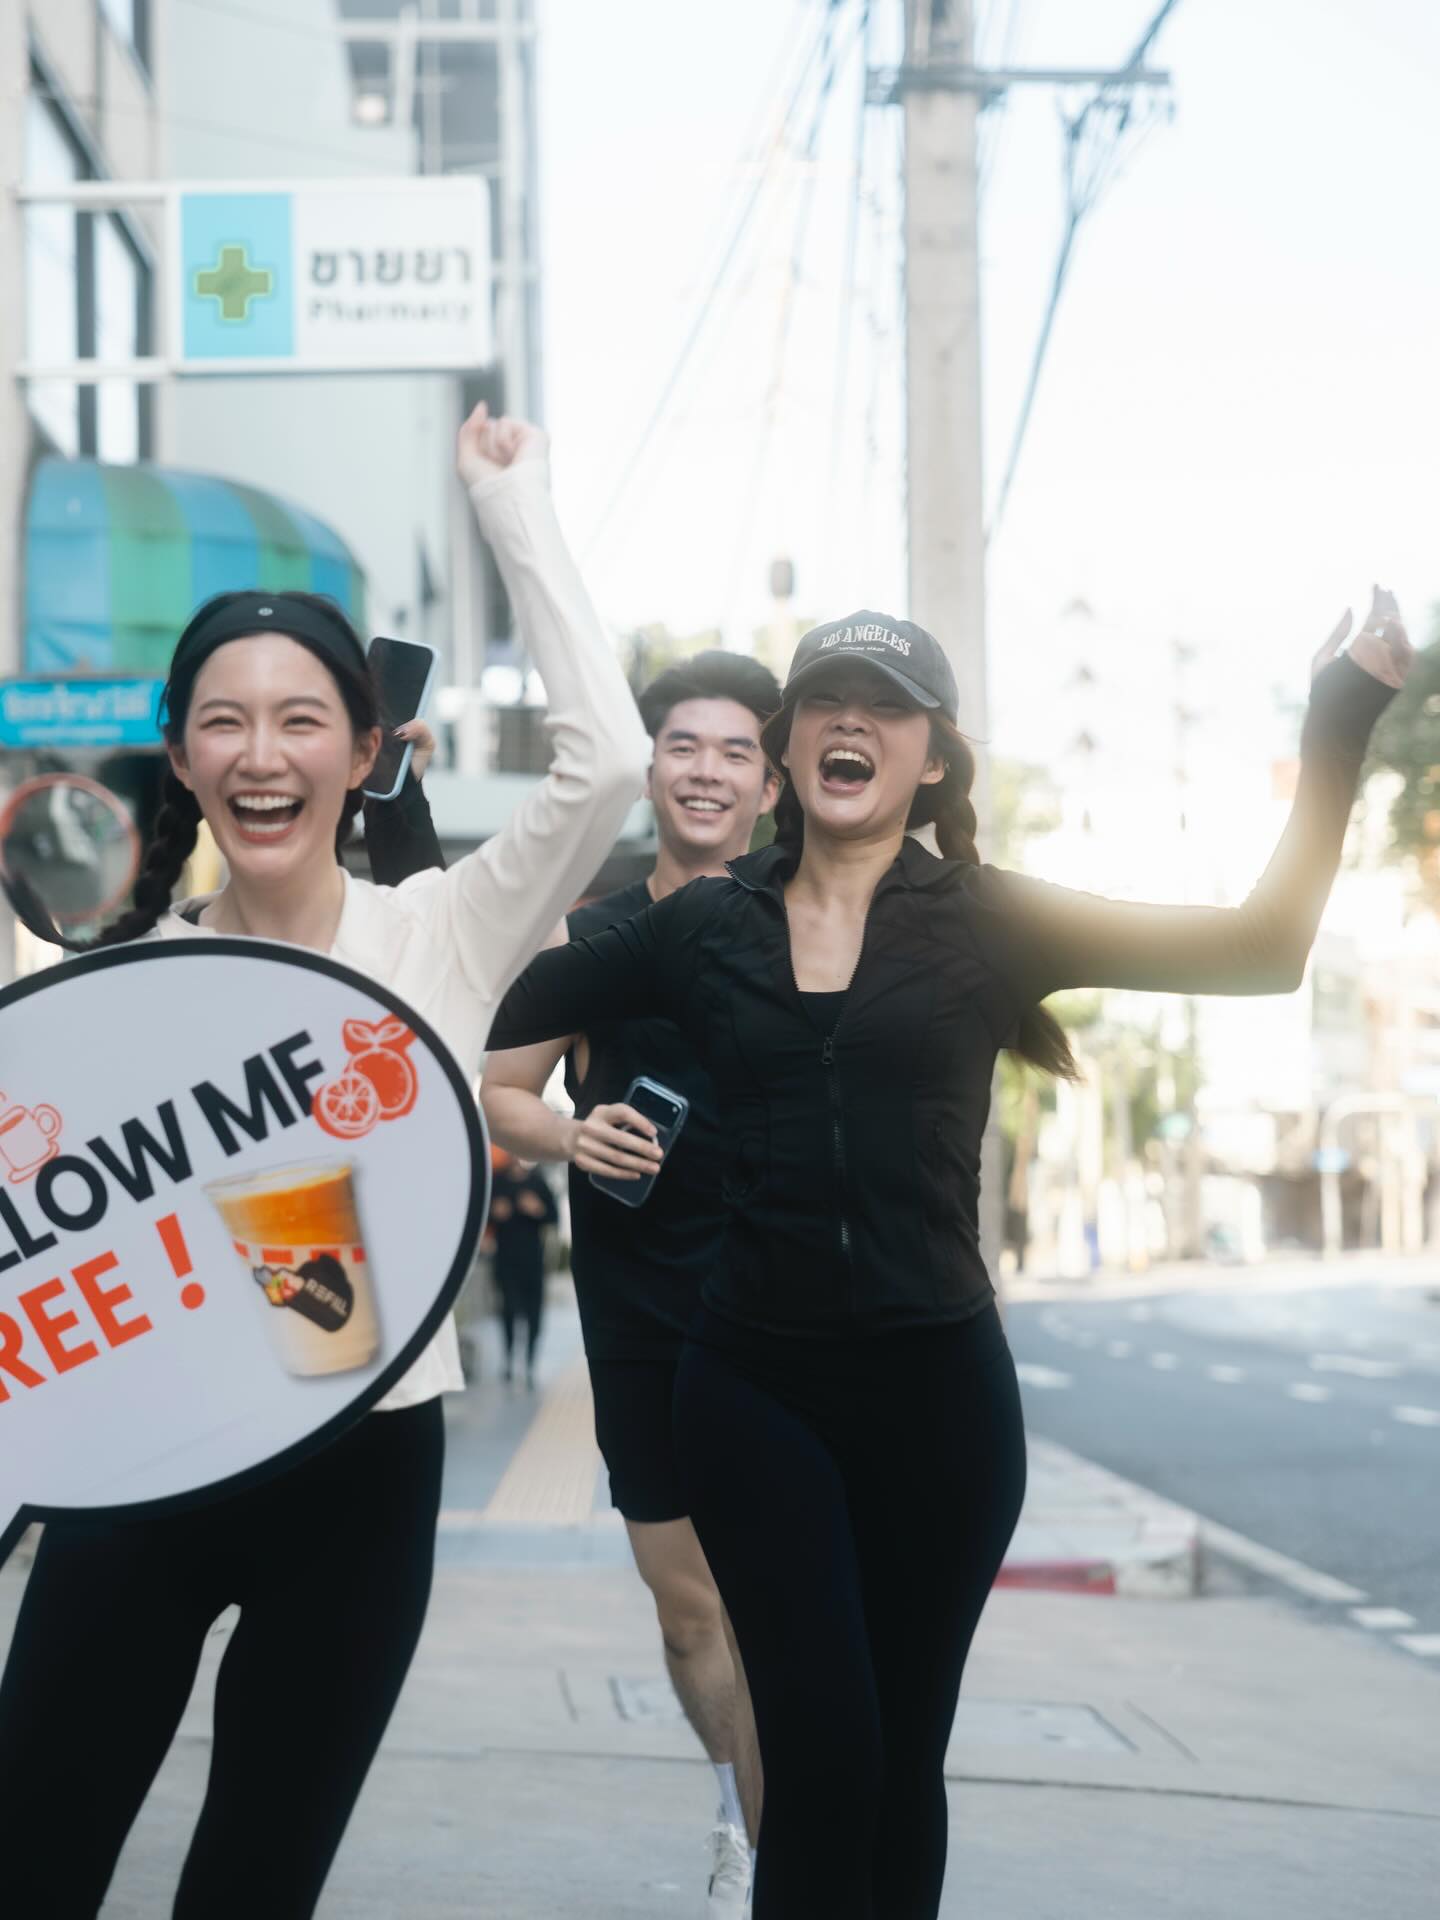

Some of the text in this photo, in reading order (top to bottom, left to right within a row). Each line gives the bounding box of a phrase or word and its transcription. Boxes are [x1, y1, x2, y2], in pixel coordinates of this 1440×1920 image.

[310, 300, 472, 325] Pharmacy
[819, 624, 911, 656] LOS ANGELESS
